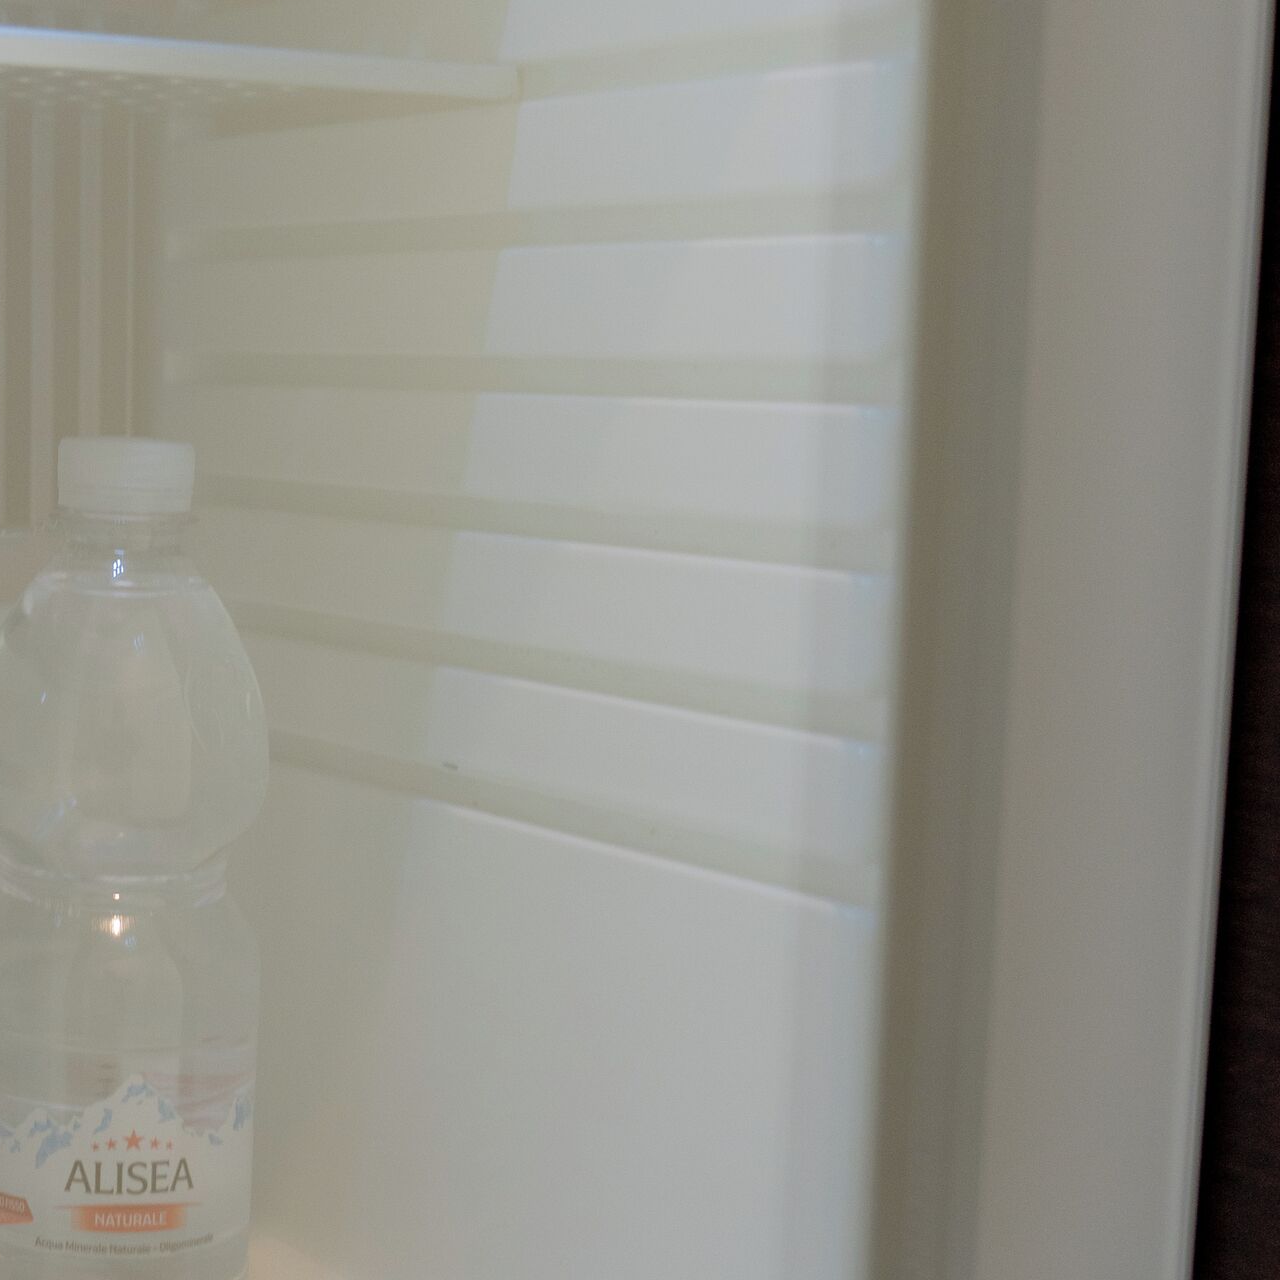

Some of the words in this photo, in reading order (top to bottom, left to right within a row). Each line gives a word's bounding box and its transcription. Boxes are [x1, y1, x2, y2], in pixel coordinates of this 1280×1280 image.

[64, 1157, 194, 1195] ALISEA
[94, 1211, 167, 1228] NATURALE
[34, 1236, 63, 1252] Acqua
[65, 1240, 107, 1254] Minerale
[109, 1243, 152, 1255] Naturale
